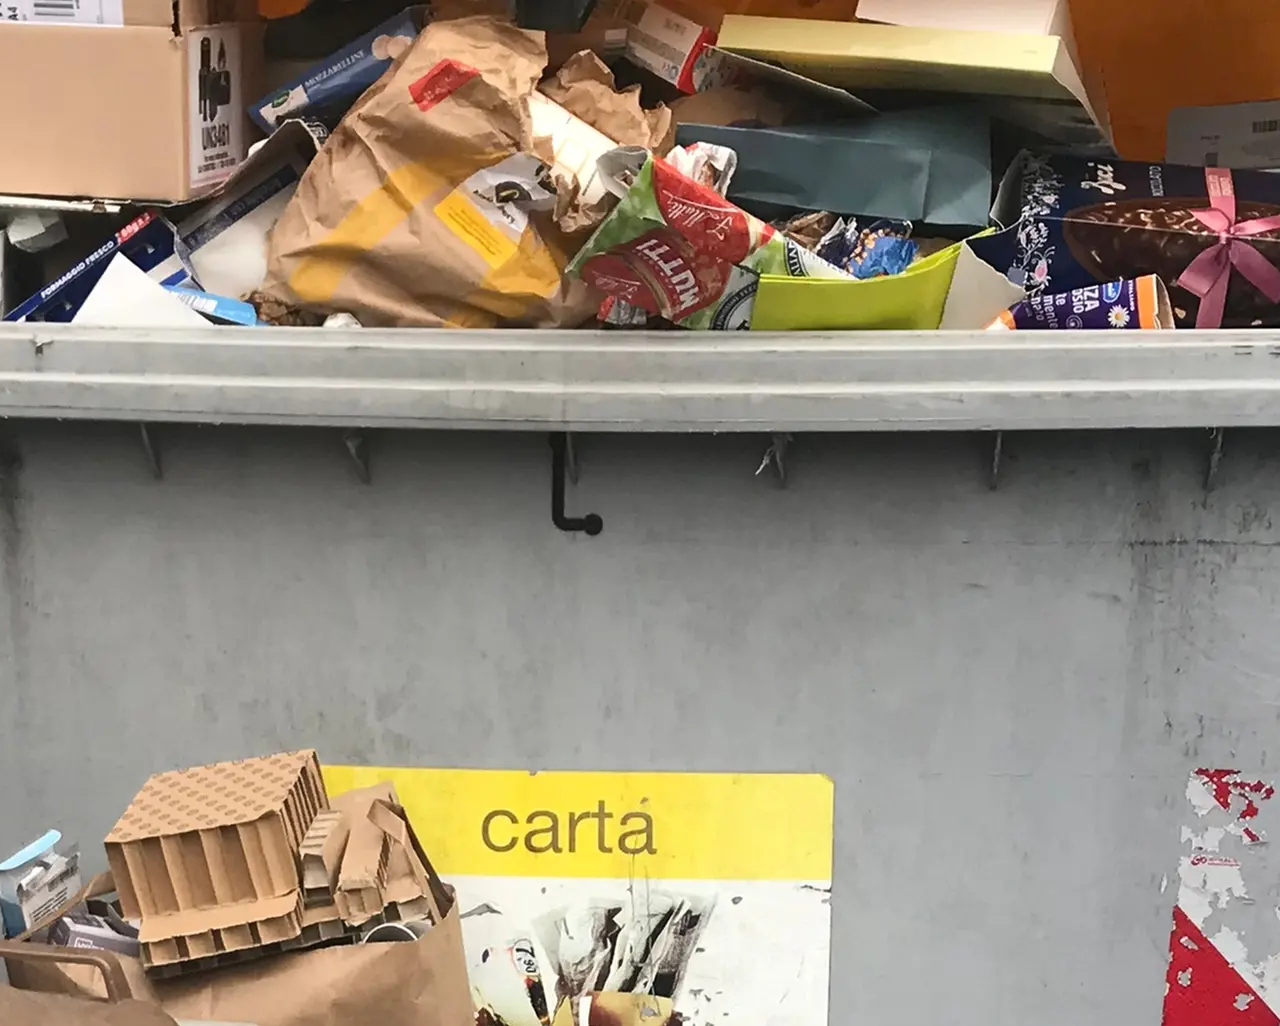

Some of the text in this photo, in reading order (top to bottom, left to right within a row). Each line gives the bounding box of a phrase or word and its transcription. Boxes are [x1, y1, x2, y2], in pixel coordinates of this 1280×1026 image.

[40, 240, 115, 299] FORMAGGIO FRESCO
[635, 238, 701, 312] MUTTI
